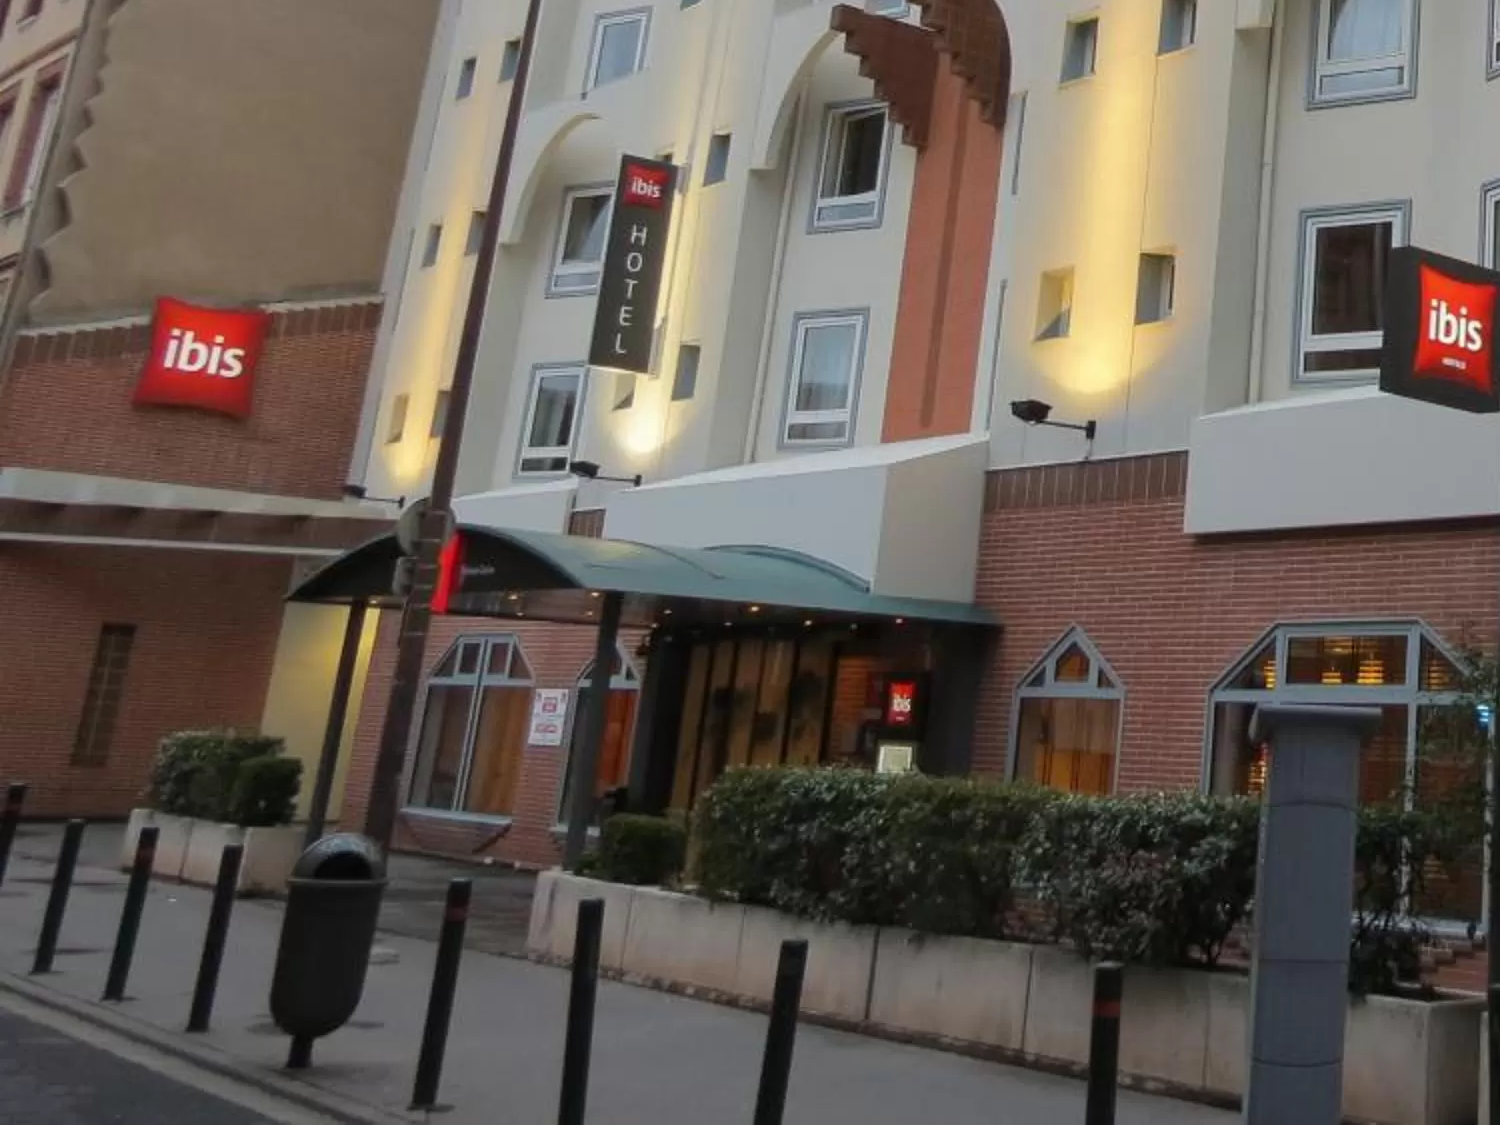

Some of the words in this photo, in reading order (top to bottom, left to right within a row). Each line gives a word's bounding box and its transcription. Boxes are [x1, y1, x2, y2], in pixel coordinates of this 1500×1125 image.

[631, 176, 662, 198] ibis
[614, 224, 648, 354] HOTEL
[1428, 298, 1483, 352] ibis
[163, 327, 245, 378] ibis
